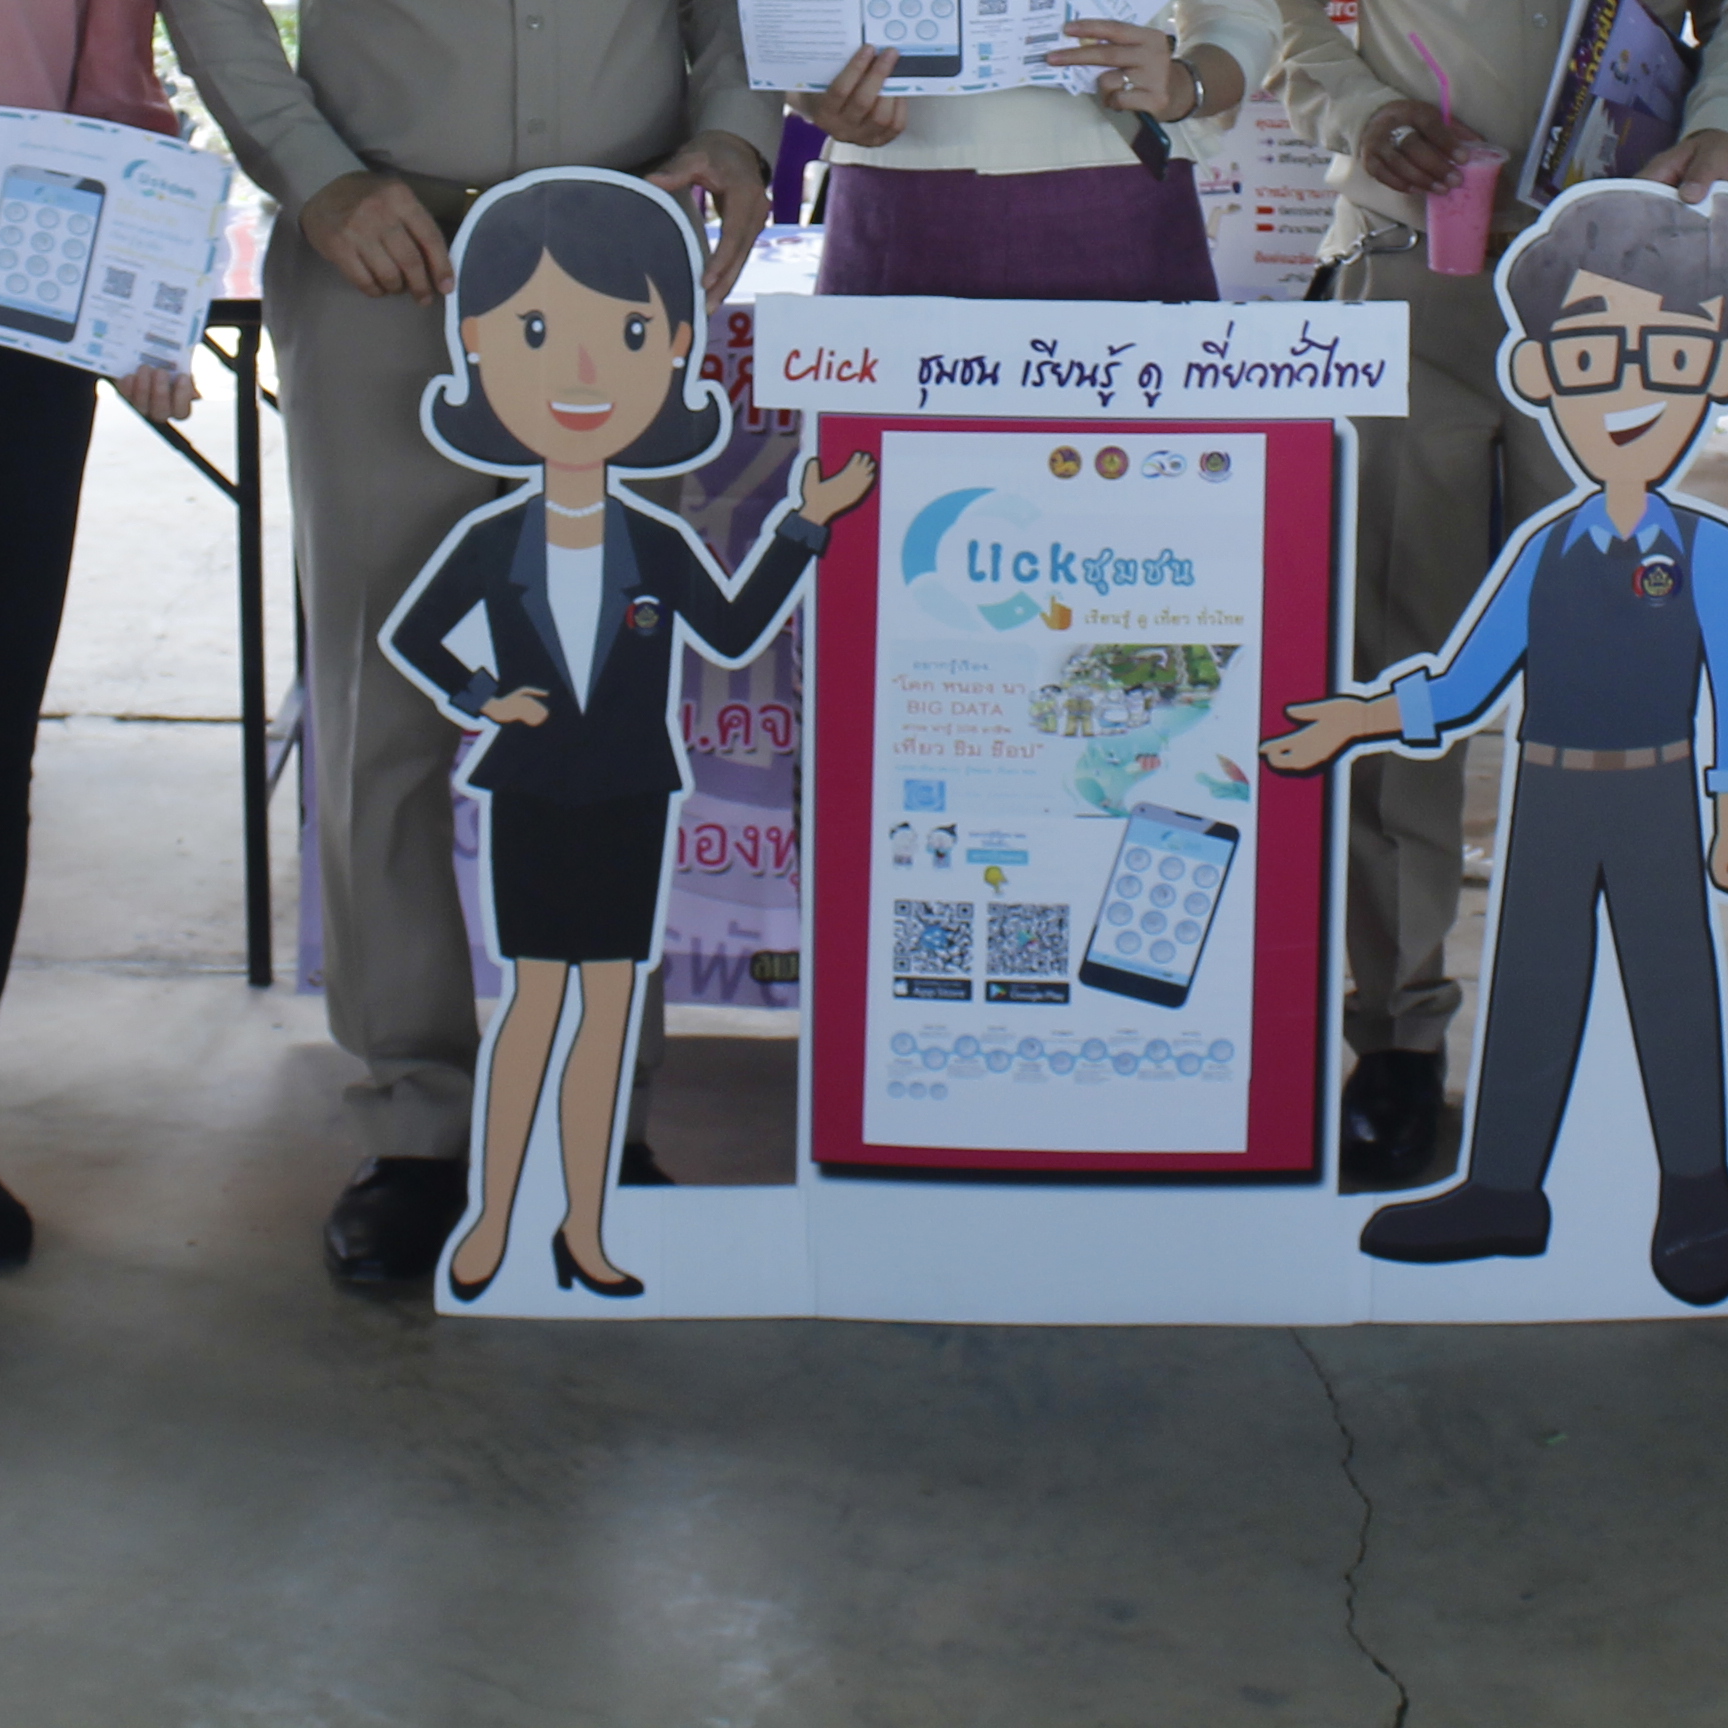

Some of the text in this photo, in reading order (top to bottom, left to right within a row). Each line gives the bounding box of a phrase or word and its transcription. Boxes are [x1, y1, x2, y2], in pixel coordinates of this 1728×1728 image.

[784, 347, 880, 384] Click
[918, 352, 1001, 409] ชุมชน
[1022, 339, 1138, 408] เรียนรู้
[1138, 358, 1165, 409] ดู
[907, 700, 1004, 716] BIG DATA
